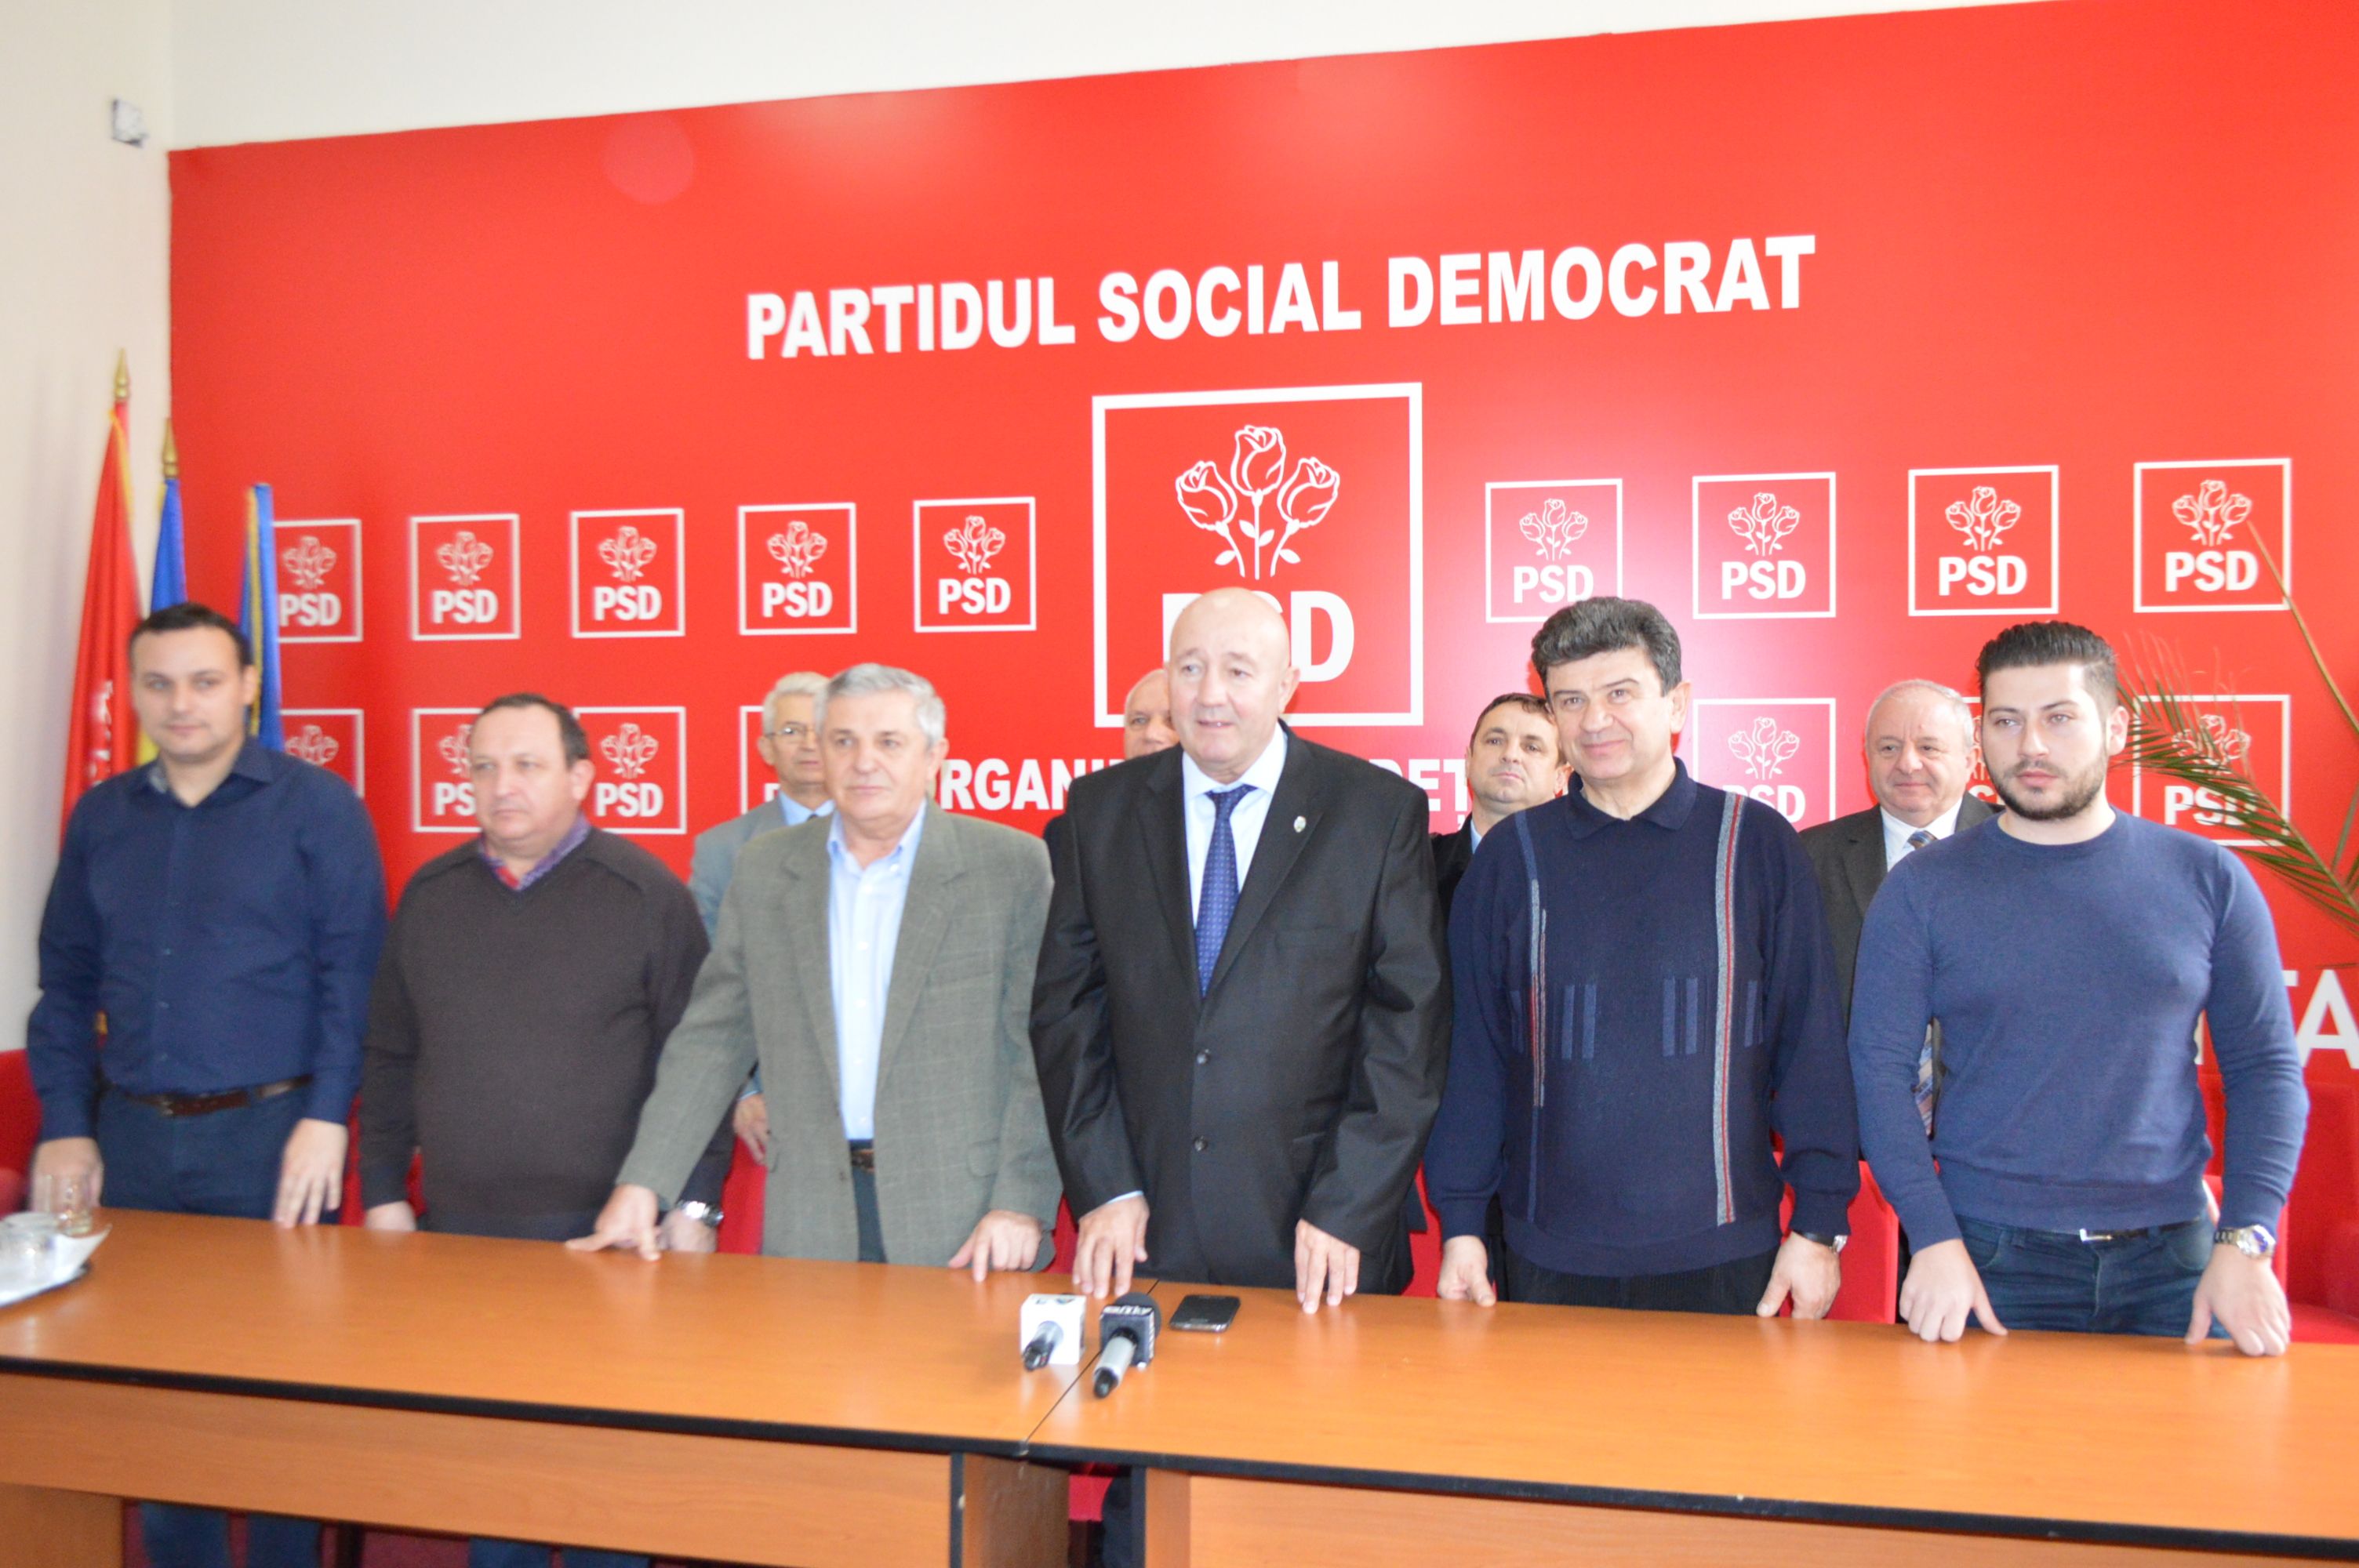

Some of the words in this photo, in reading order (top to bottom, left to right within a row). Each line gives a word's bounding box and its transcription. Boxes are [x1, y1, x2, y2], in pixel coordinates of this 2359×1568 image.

[748, 277, 1075, 360] PARTIDUL
[1098, 260, 1364, 343] SOCIAL
[1388, 235, 1816, 328] DEMOCRAT
[1514, 565, 1594, 604] PSD
[1721, 560, 1806, 601] PSD
[1939, 555, 2027, 596] PSD
[2165, 550, 2259, 593] PSD
[278, 593, 341, 627] PSD
[433, 590, 498, 624] PSD
[594, 586, 662, 621] PSD
[763, 582, 833, 618] PSD
[939, 578, 1011, 615] PSD
[434, 782, 476, 816] PS
[597, 782, 664, 818] PSD
